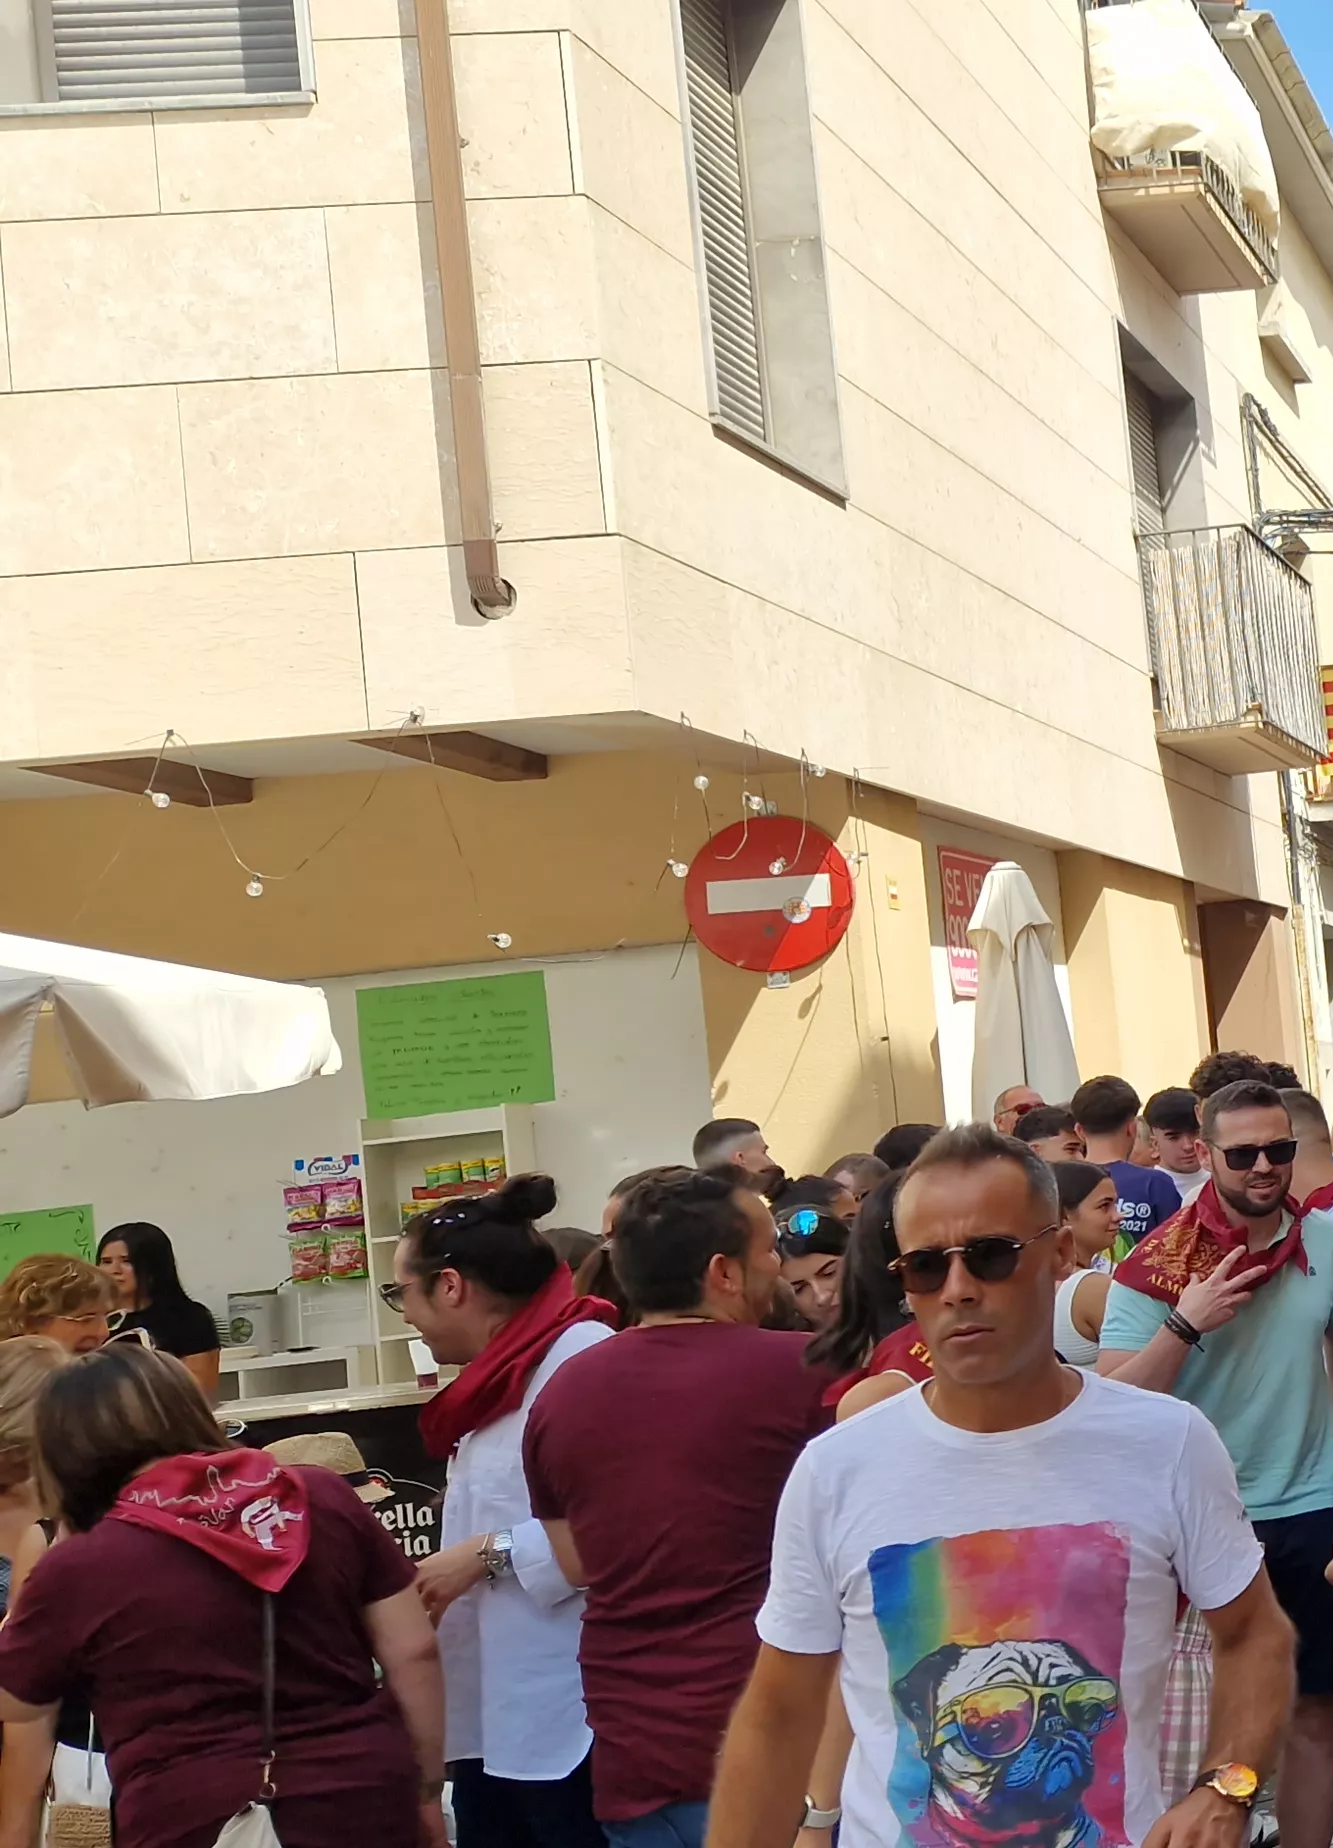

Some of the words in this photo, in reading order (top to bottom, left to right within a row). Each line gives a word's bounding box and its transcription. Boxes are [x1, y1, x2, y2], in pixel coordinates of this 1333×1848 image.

[945, 868, 964, 906] SE
[314, 1163, 344, 1172] VIDAL
[1119, 1219, 1148, 1232] 2021
[374, 1503, 436, 1531] ella
